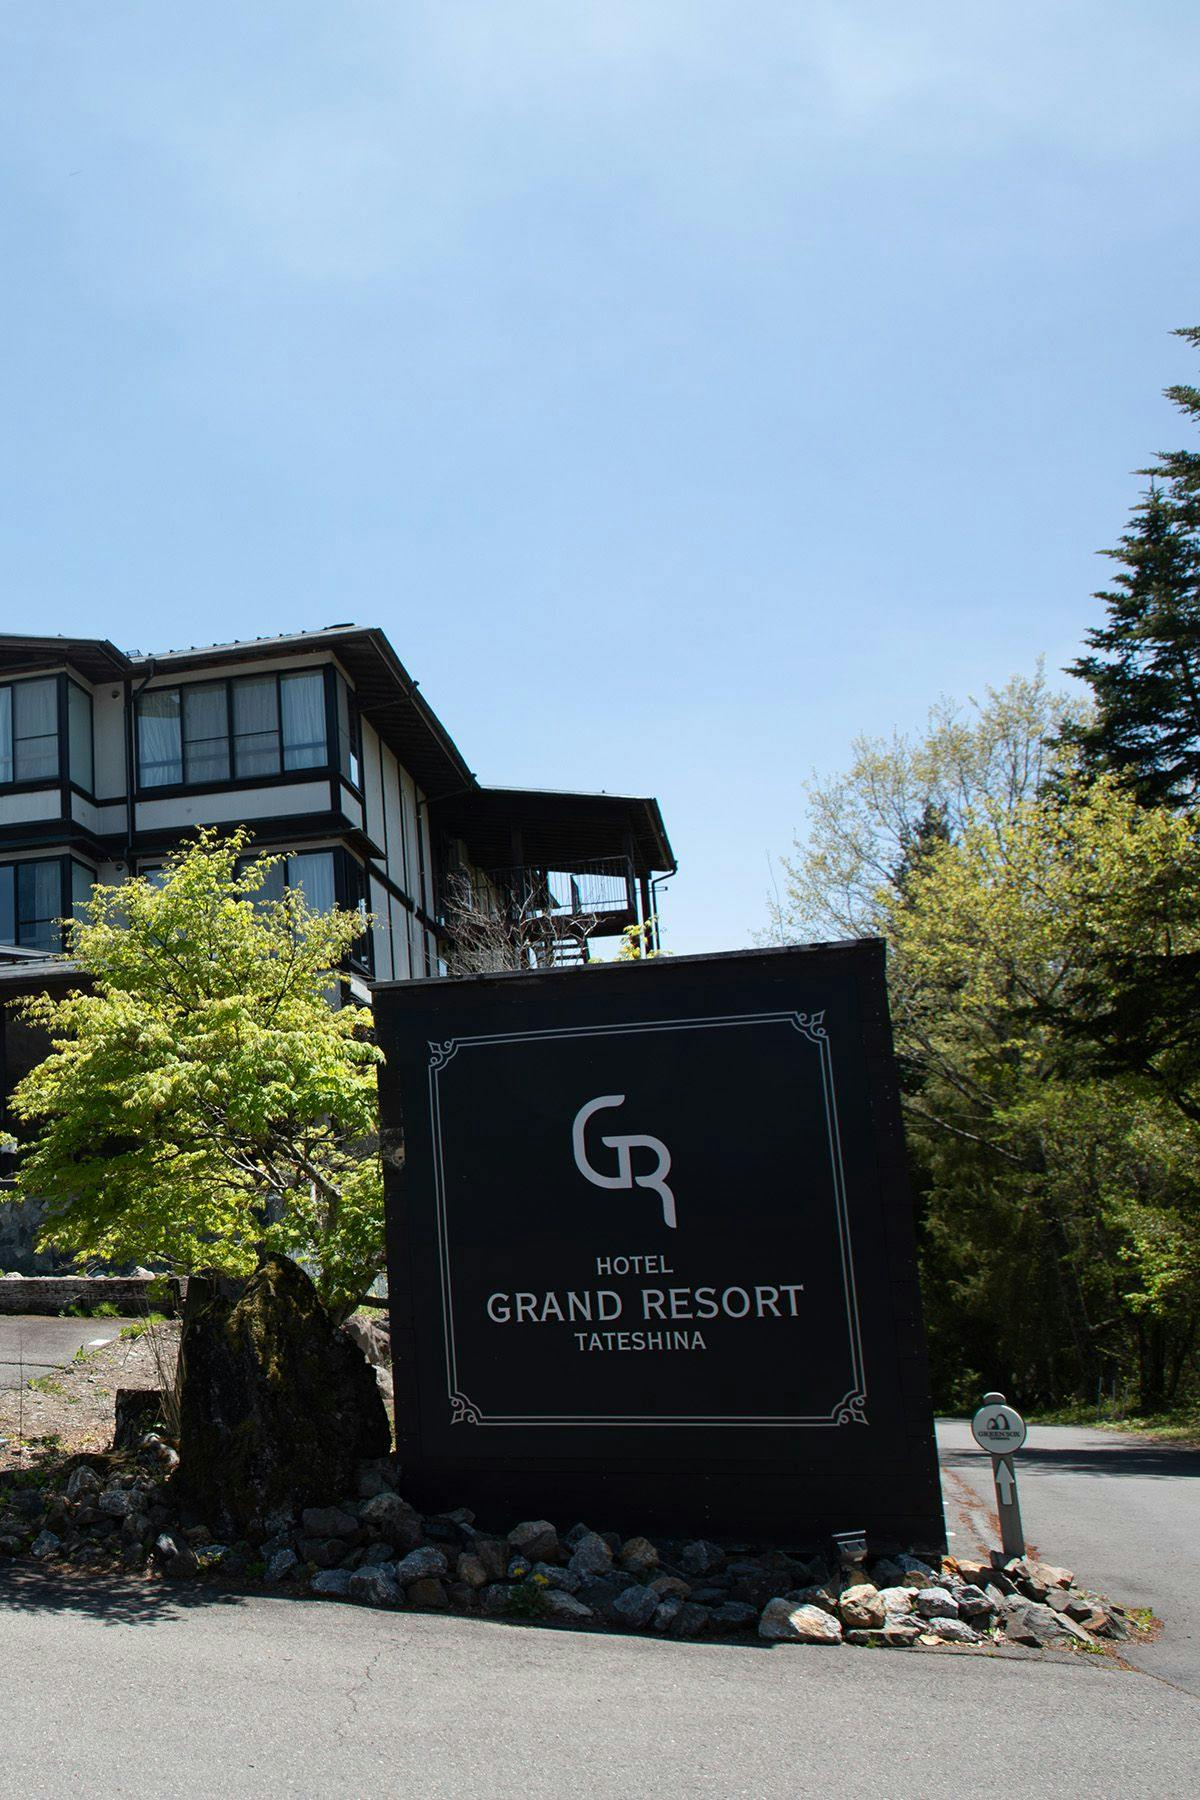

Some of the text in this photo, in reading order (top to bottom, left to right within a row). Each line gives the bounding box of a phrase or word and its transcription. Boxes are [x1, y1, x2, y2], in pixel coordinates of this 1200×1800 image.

[596, 1255, 674, 1276] HOTEL
[487, 1284, 804, 1323] GRAND RESORT
[574, 1331, 707, 1351] TATESHINA
